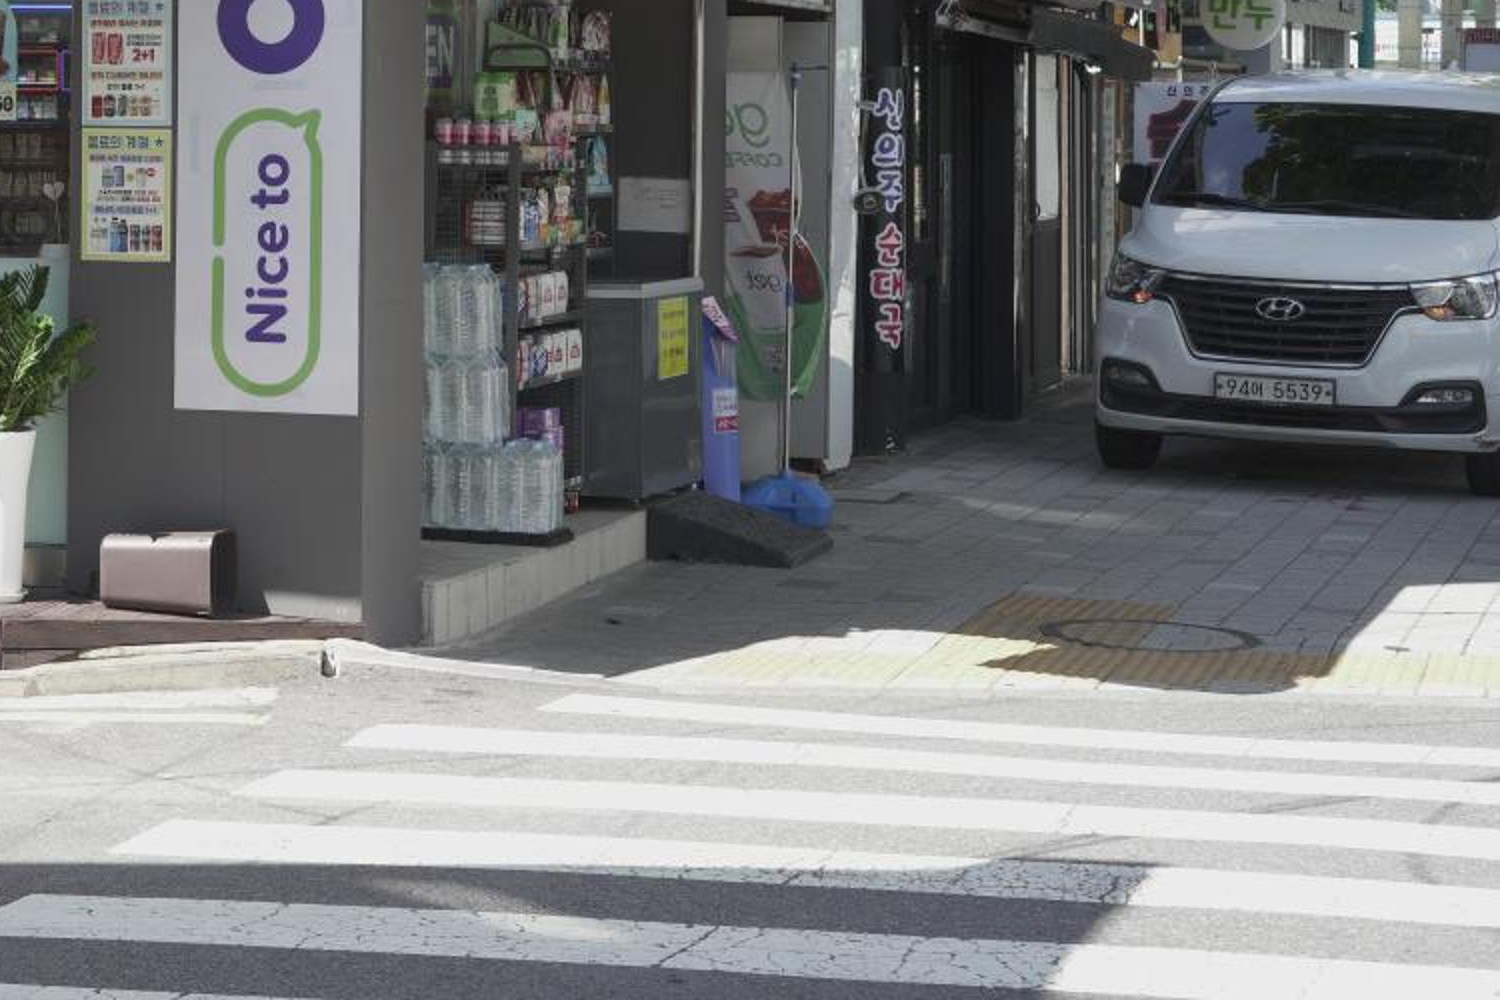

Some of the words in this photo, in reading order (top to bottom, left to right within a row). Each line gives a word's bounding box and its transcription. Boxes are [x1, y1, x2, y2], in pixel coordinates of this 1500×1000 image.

[132, 48, 155, 63] 2+1
[425, 22, 455, 79] EN
[250, 152, 290, 209] to
[245, 221, 290, 344] Nice
[869, 220, 905, 350] 순대국
[1272, 381, 1323, 401] 5539
